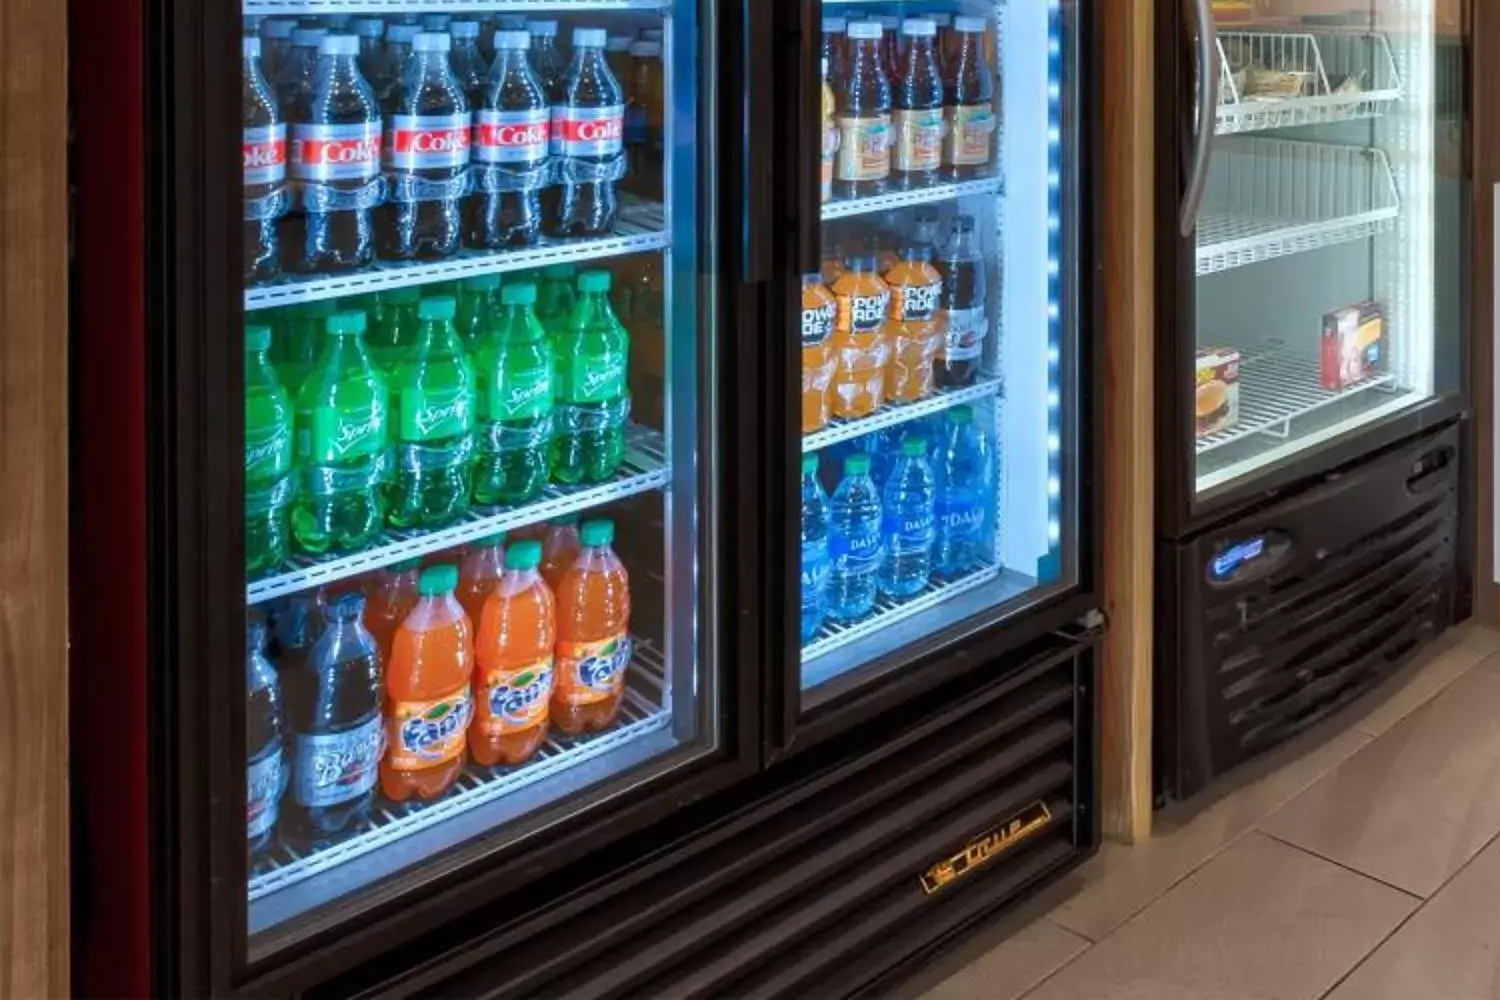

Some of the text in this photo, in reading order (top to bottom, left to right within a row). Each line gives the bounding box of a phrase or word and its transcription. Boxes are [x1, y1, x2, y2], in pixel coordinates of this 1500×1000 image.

[413, 130, 469, 154] Coke
[499, 124, 548, 146] Coke
[243, 148, 278, 167] oke
[321, 140, 378, 164] Coke
